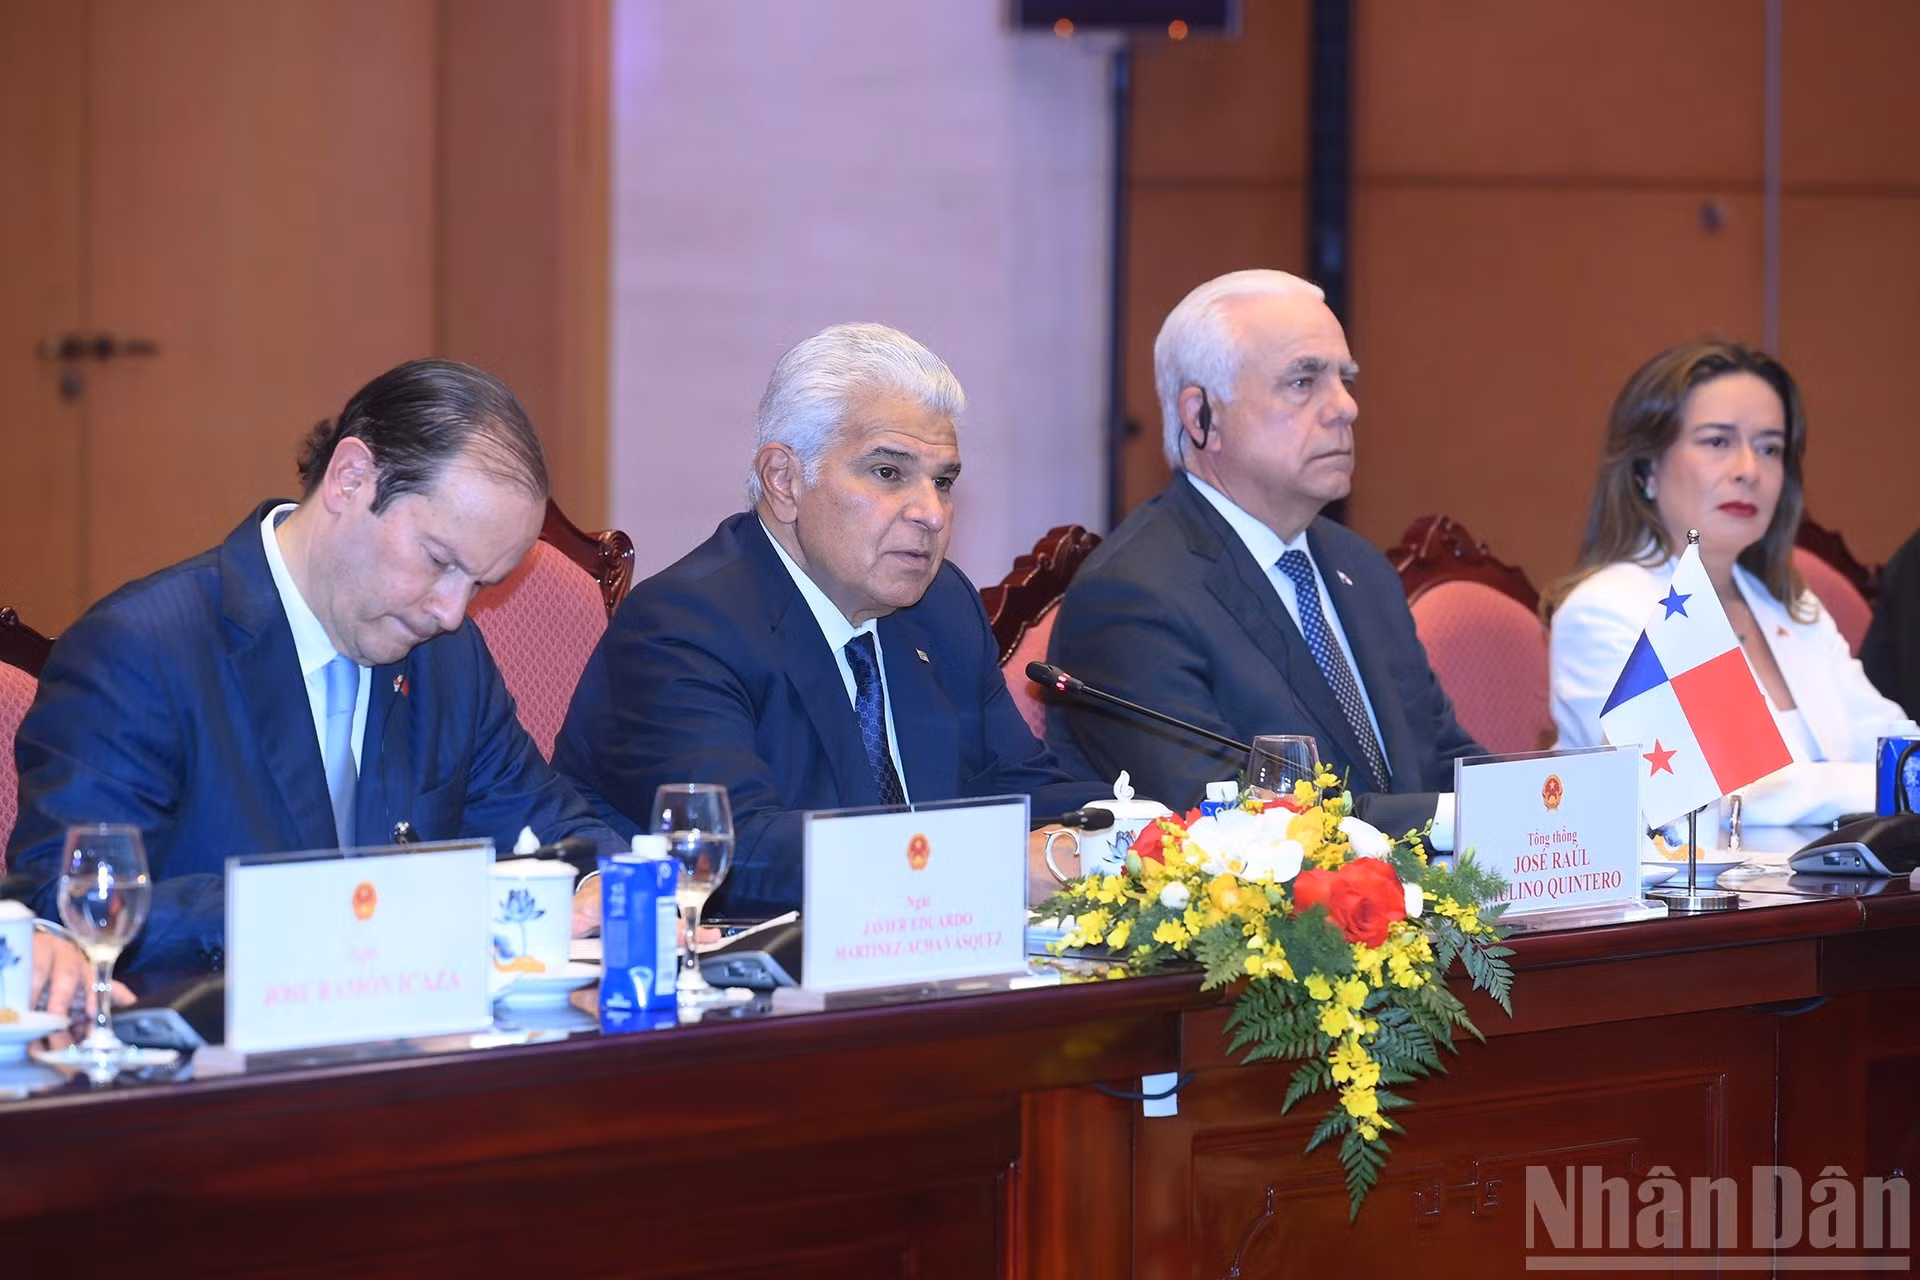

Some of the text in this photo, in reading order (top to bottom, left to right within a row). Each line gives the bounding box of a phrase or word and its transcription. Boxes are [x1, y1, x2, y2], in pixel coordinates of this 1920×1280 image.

[1528, 825, 1577, 848] Tổng thống
[1514, 844, 1590, 874] JOSÉ RAÚL
[1547, 870, 1622, 899] QUINTERO
[911, 912, 974, 932] EDUARDO
